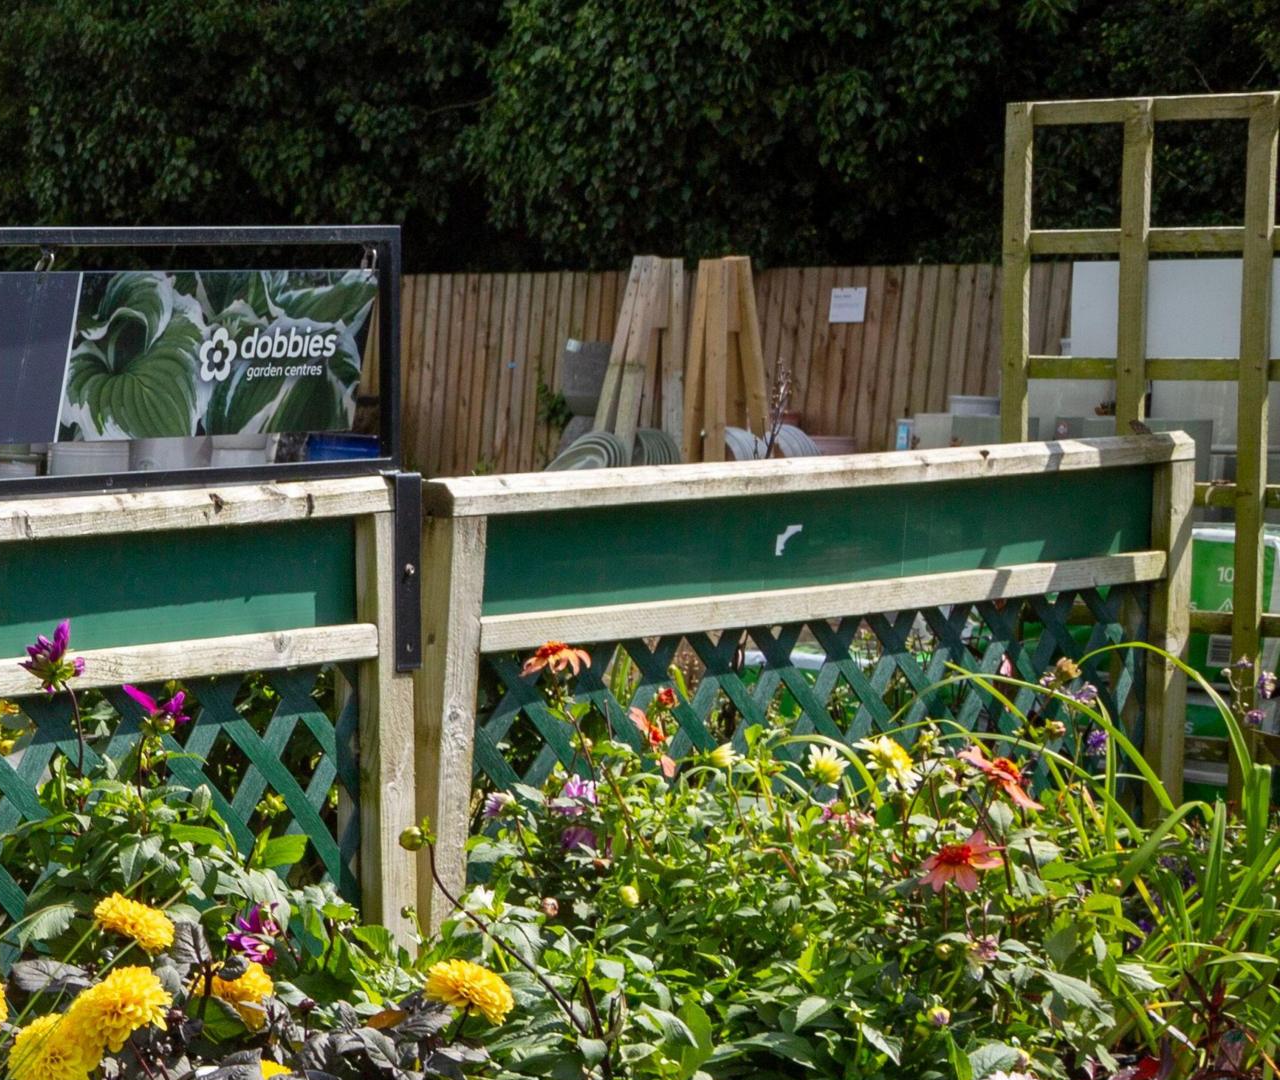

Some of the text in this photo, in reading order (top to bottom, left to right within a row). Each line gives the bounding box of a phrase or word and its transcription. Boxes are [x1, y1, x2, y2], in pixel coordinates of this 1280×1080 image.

[241, 326, 337, 359] dobbies
[246, 363, 322, 381] garden centres
